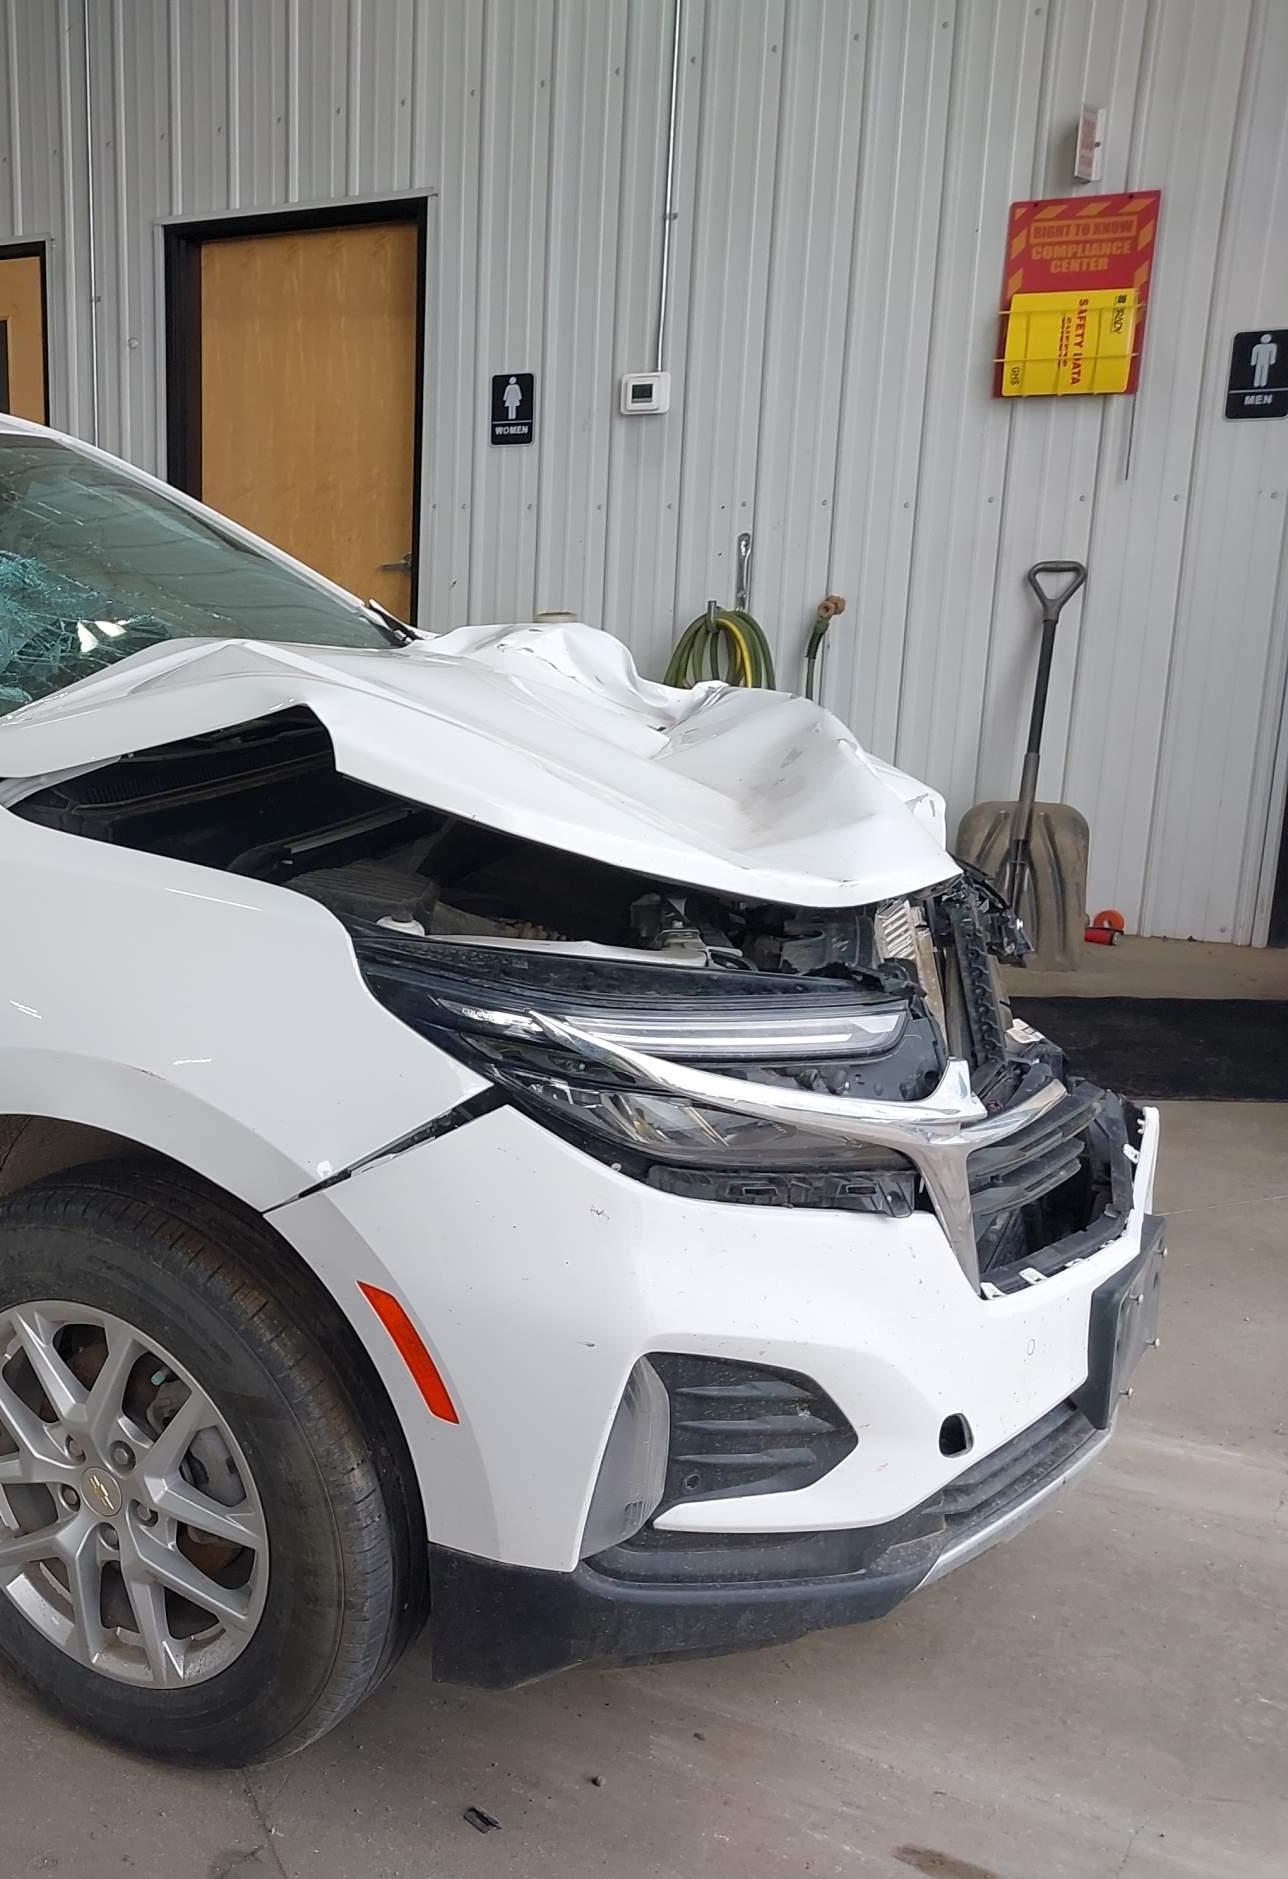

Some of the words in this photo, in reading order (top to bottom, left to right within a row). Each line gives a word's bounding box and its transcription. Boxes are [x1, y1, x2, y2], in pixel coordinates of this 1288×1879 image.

[1032, 223, 1073, 239] RIGHT
[1075, 223, 1091, 237] TO
[1092, 220, 1134, 235] KNOW
[1032, 240, 1131, 260] COMPLIANCE
[1050, 257, 1108, 273] CENTER
[1073, 298, 1089, 348] SAFETY
[1070, 353, 1083, 384] DATA
[1244, 394, 1273, 405] MEN
[494, 425, 529, 435] WOMEN
